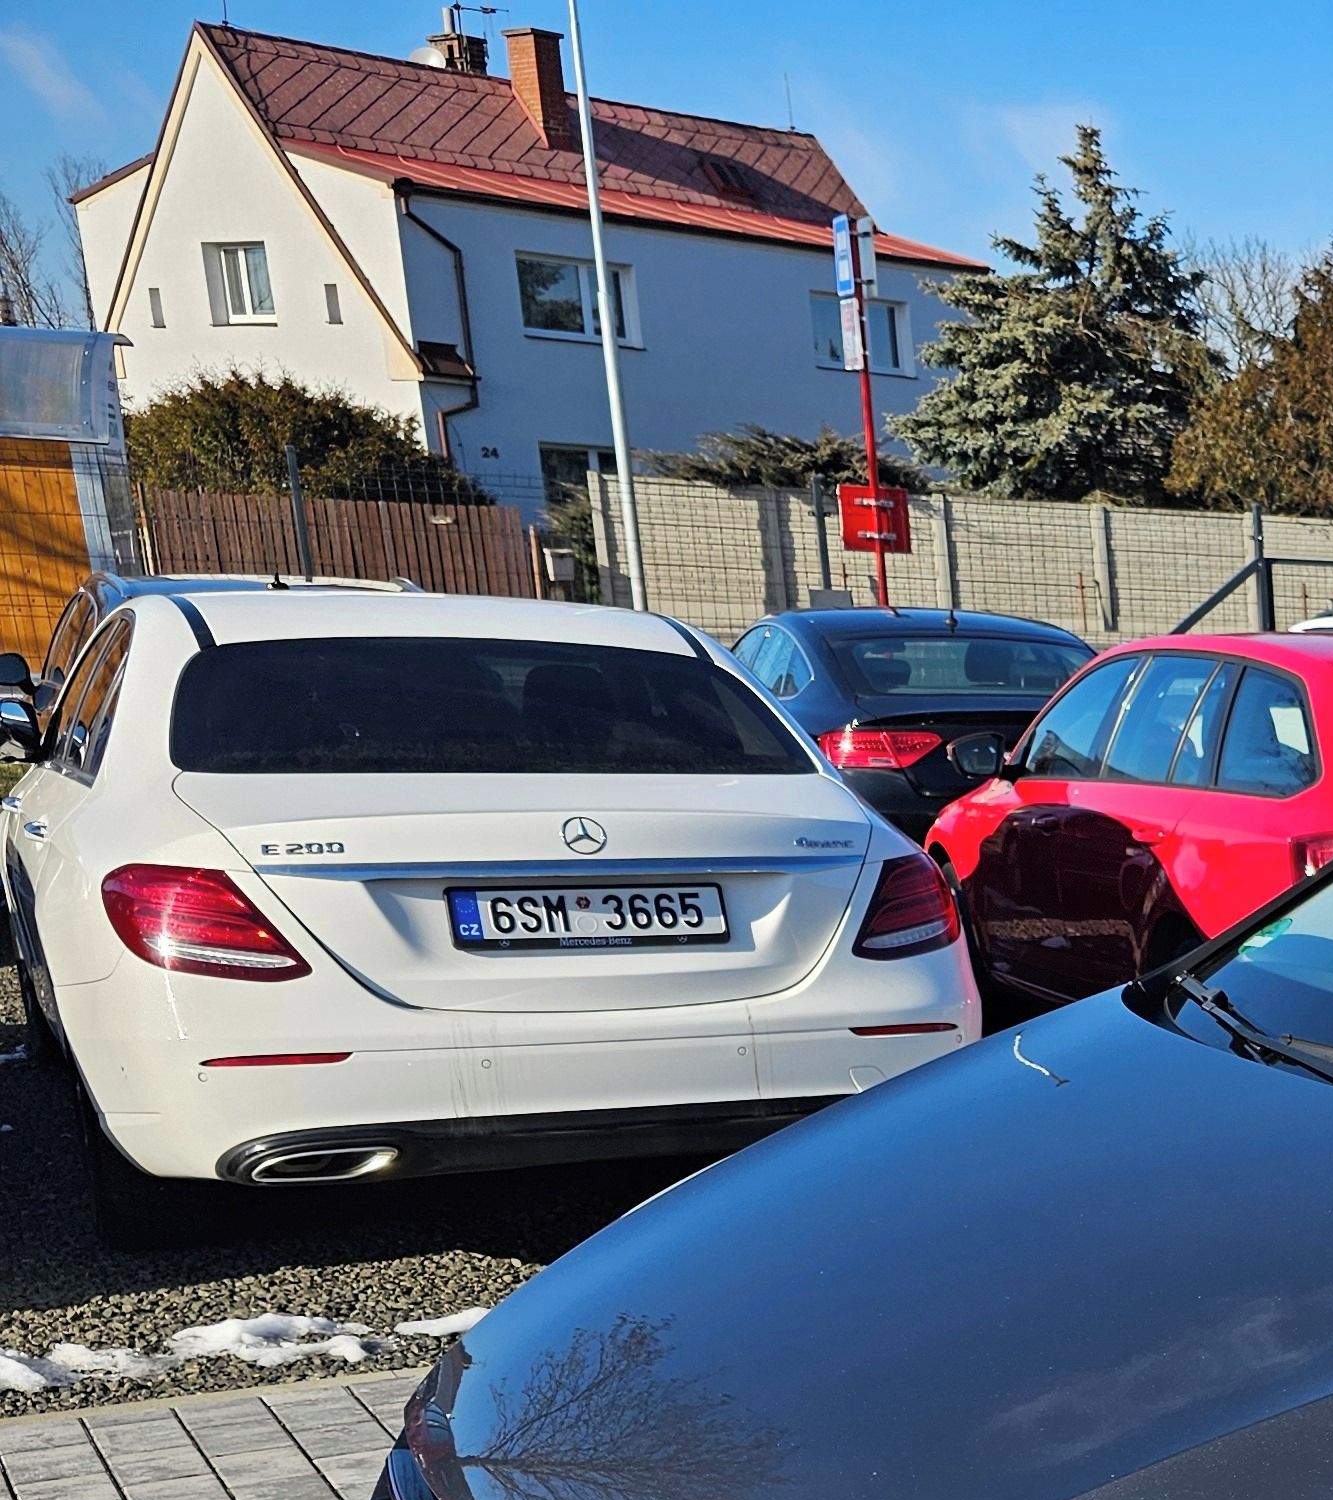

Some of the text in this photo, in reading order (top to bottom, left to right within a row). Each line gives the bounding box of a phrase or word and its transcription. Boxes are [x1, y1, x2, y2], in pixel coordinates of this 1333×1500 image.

[481, 446, 500, 459] 24
[261, 842, 345, 855] E 200
[490, 892, 704, 933] 6SM 3665
[459, 924, 480, 936] CZ
